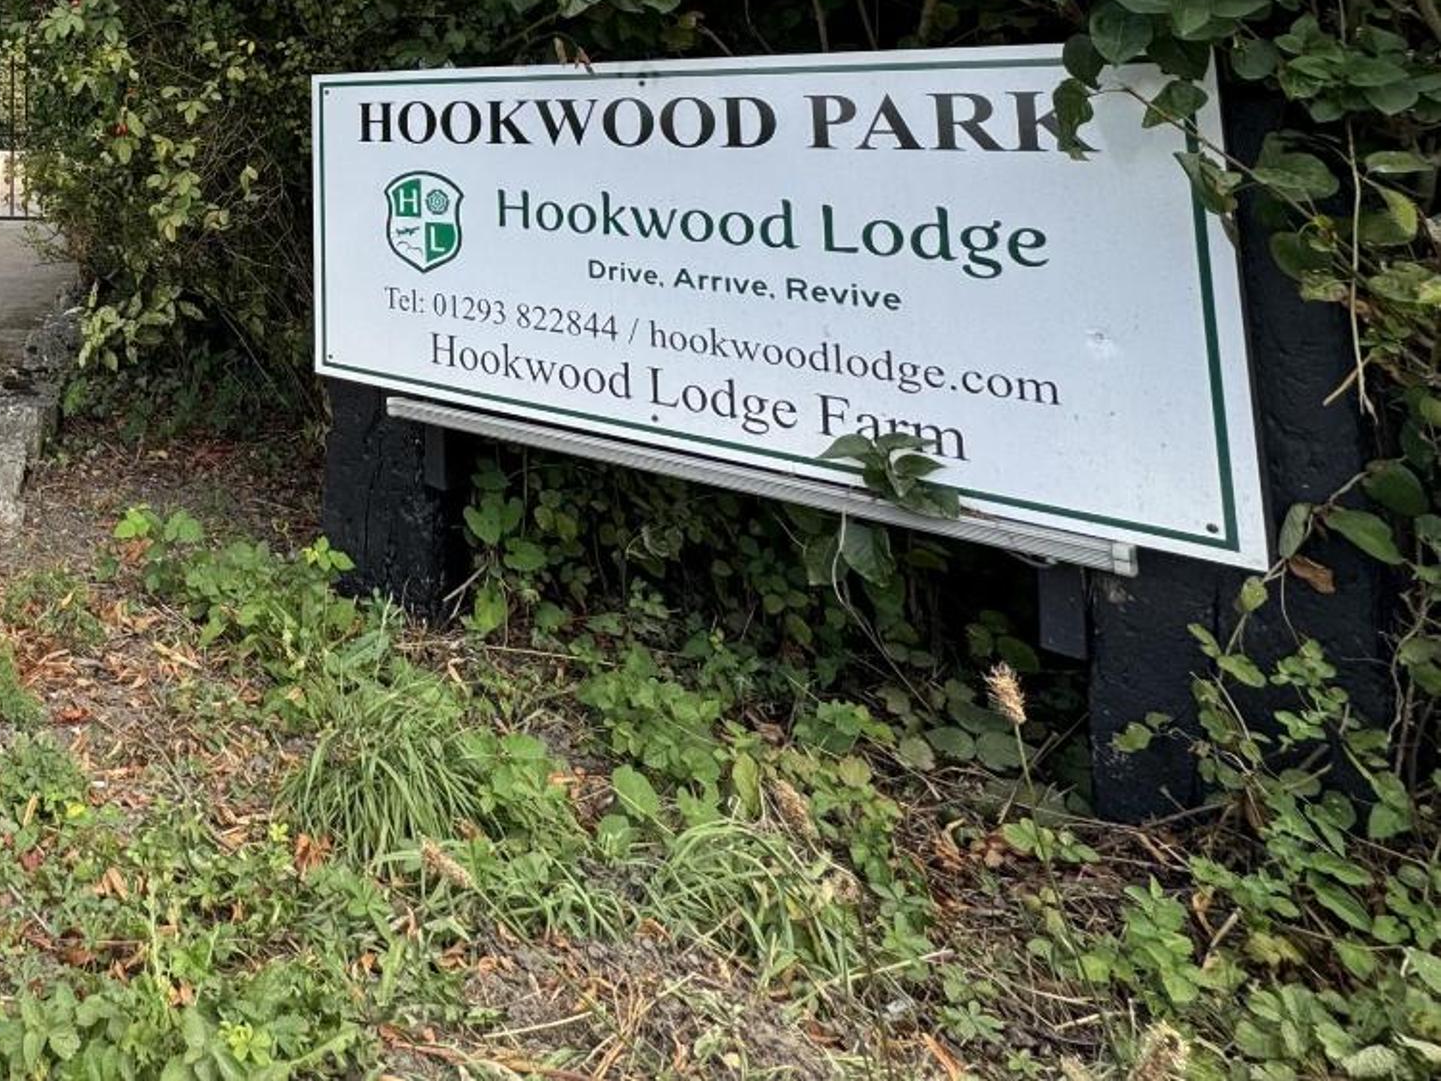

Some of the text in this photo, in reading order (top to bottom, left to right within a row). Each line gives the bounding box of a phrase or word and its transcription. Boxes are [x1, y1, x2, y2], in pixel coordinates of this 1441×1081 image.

[358, 92, 1101, 152] HOOKWOOD PARK
[398, 188, 419, 214] H
[429, 225, 446, 253] L
[497, 189, 1050, 279] Hookwood Lodge
[785, 277, 902, 311] Revive
[384, 286, 1060, 406] Tel: 01293 822844 / hookwoodlodge.com
[430, 332, 632, 400] Hookwood
[647, 366, 798, 436] Lodge
